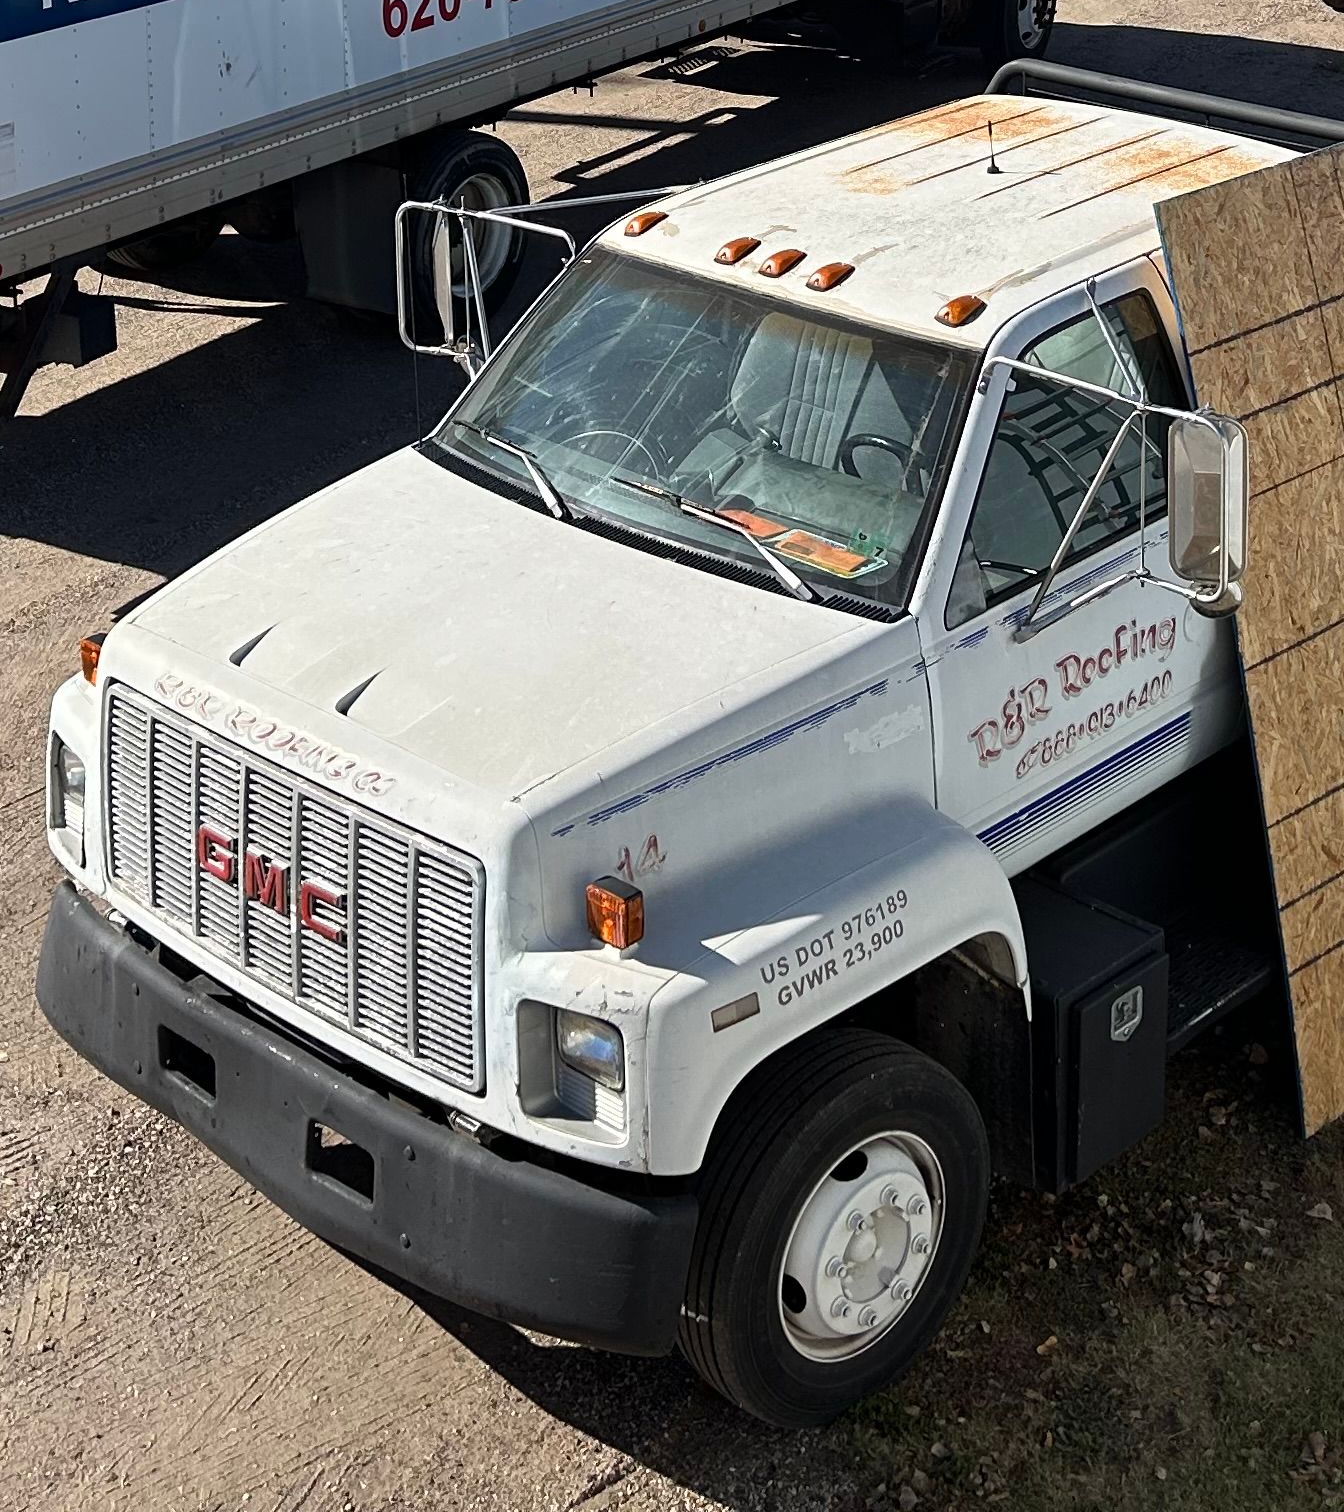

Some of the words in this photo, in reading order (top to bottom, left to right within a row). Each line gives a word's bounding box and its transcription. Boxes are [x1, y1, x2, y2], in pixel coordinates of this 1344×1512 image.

[968, 677, 1052, 768] R&R
[195, 822, 347, 943] GMC
[759, 957, 791, 985] US
[795, 928, 835, 967] DOT
[840, 888, 909, 942] 976189
[776, 959, 839, 1007] GVWR
[842, 919, 904, 970] 23,900
